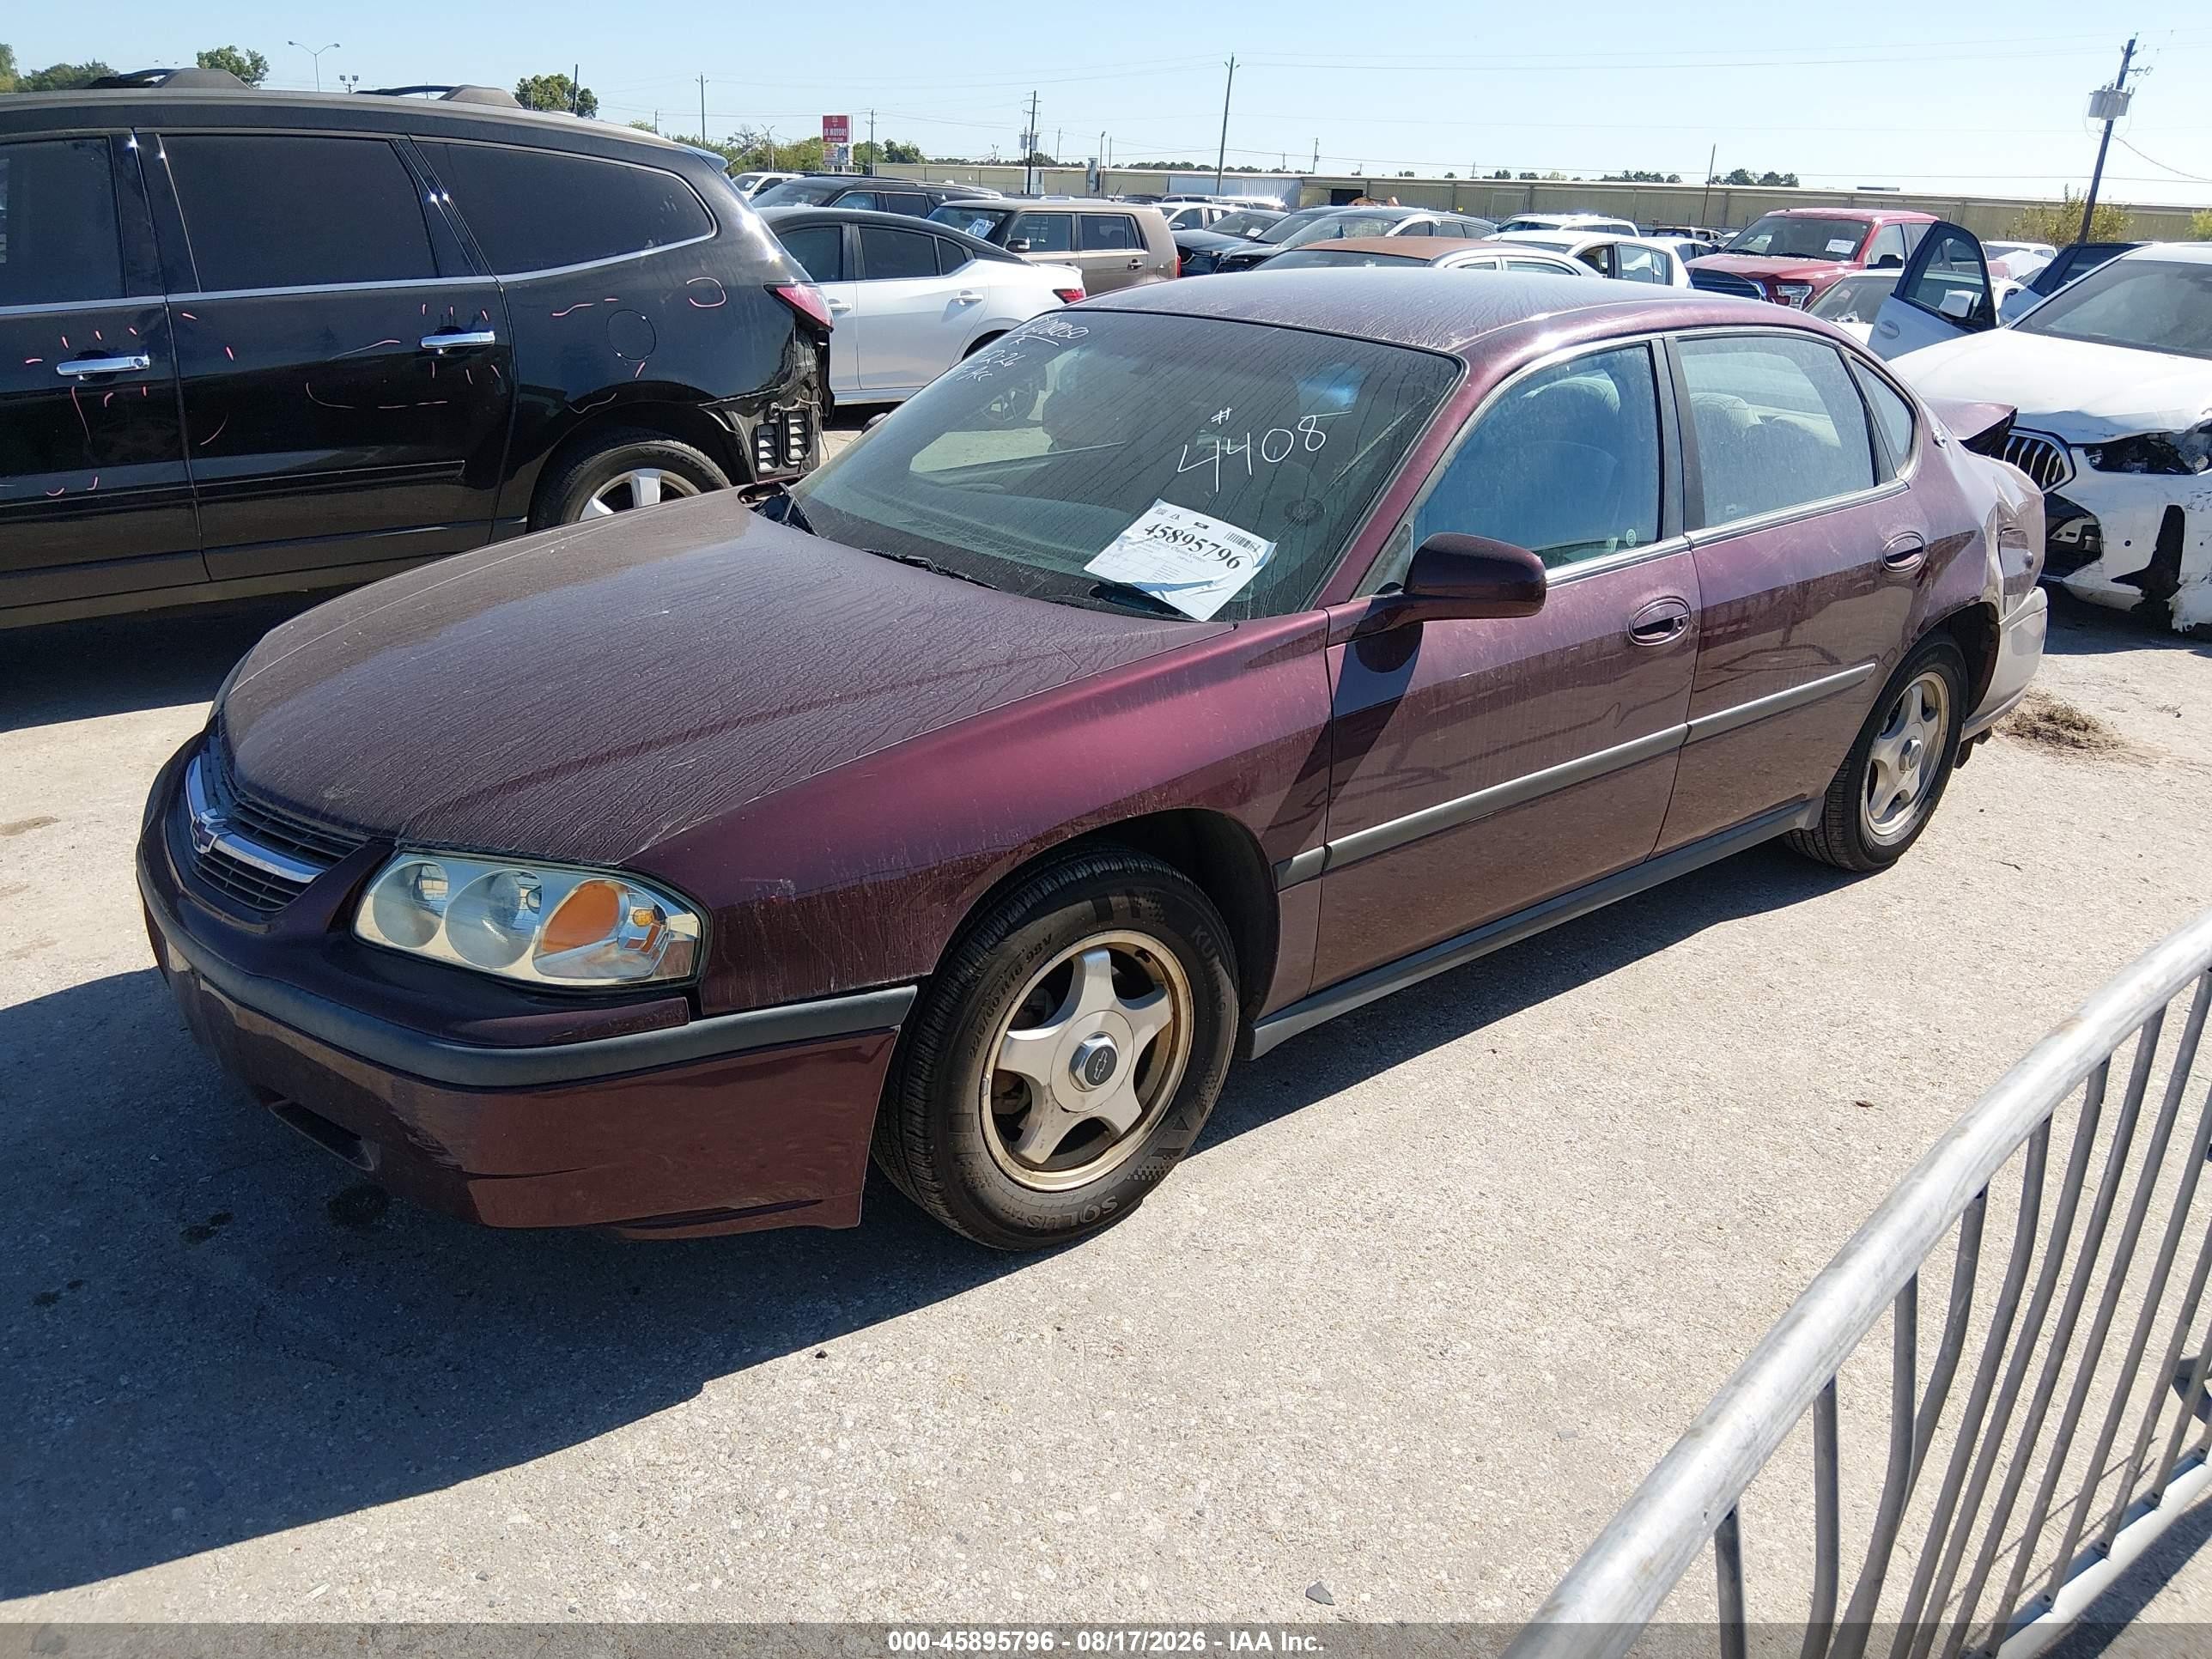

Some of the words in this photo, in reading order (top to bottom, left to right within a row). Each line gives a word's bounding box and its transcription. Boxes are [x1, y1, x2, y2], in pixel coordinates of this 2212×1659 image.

[1177, 416, 1326, 493] 4408
[1145, 523, 1248, 568] 45895796
[1025, 1195, 1119, 1230] SOLUS
